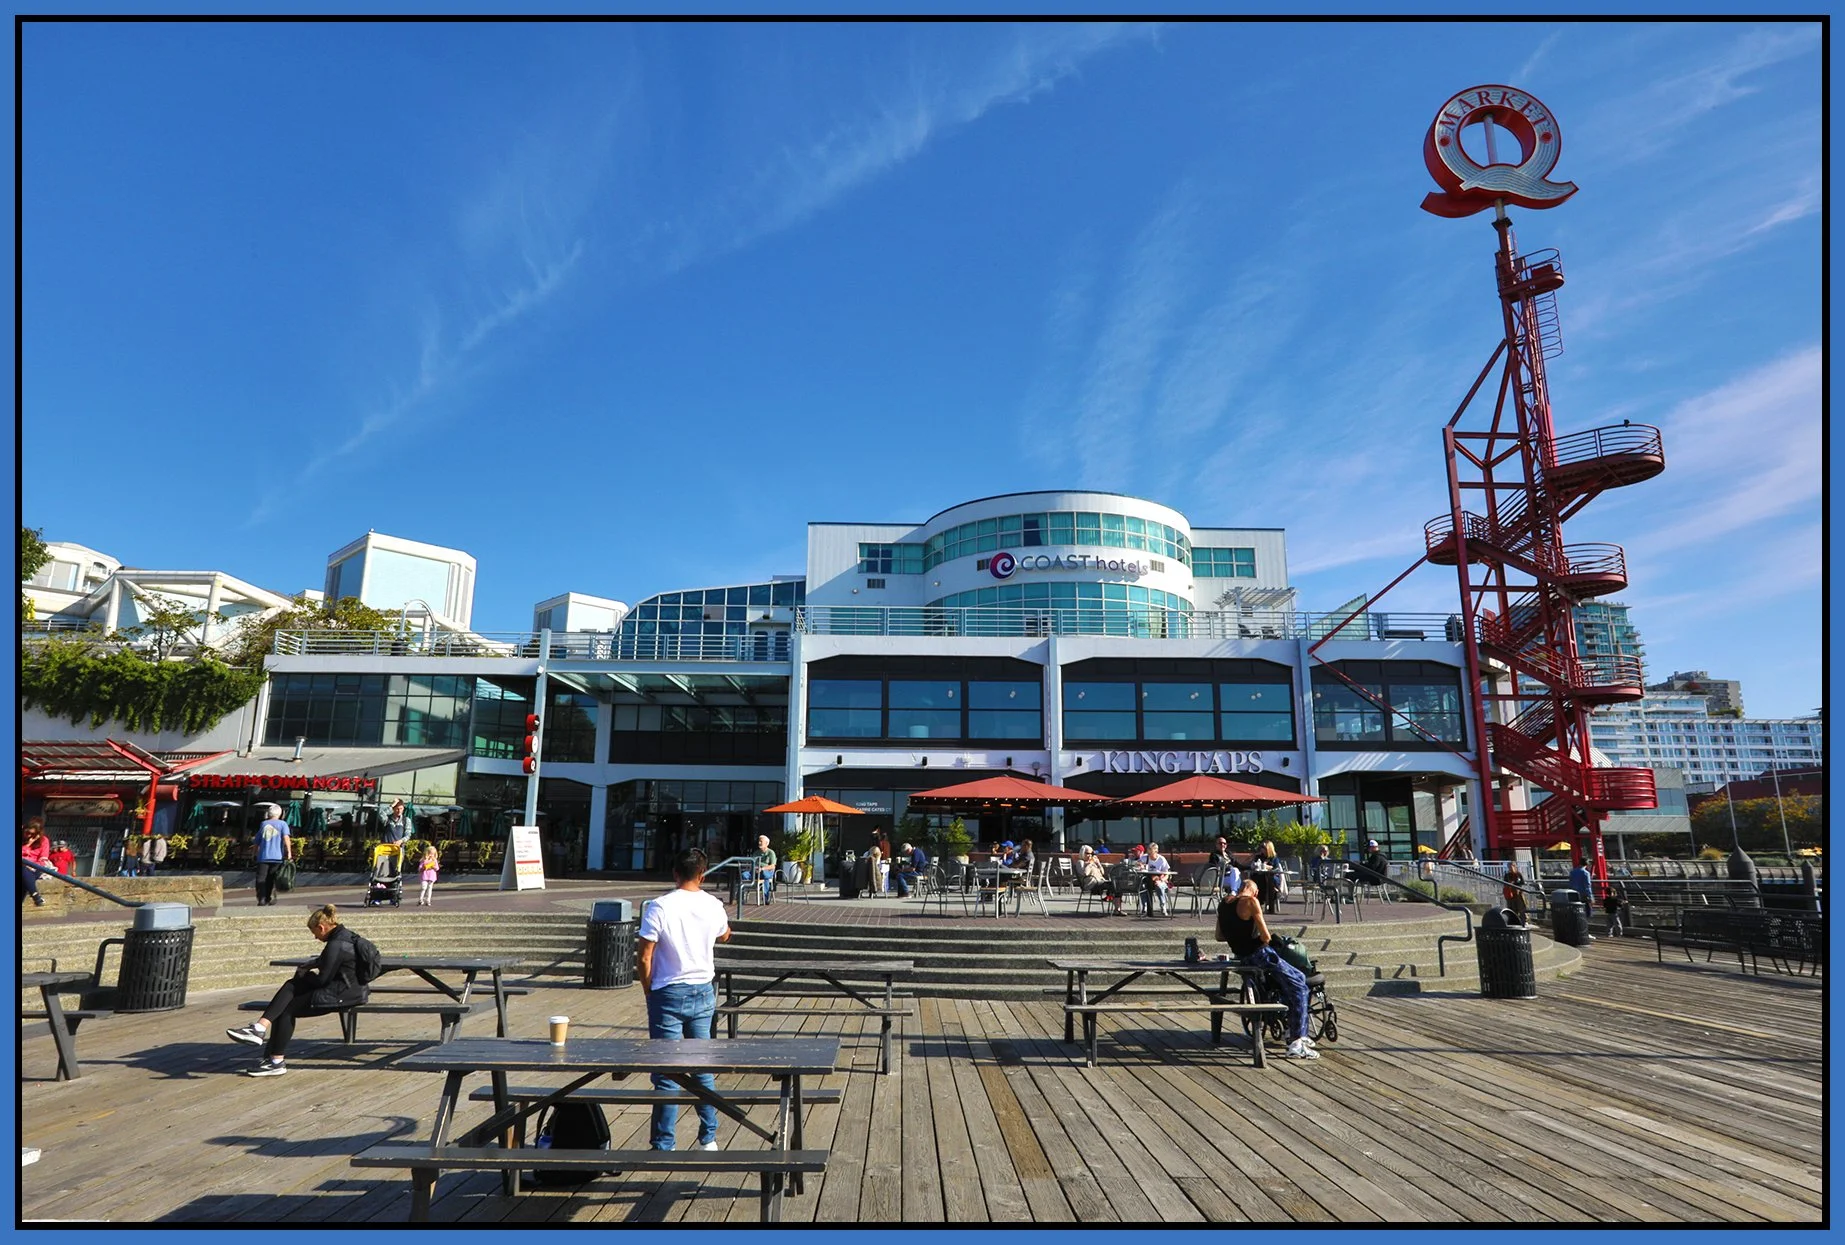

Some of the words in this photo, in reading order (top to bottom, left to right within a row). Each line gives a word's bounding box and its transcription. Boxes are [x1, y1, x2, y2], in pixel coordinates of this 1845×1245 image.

[1438, 90, 1551, 131] MARKET
[1021, 554, 1091, 571] COAST
[1096, 555, 1148, 576] hotels
[1102, 750, 1181, 774] KING
[1188, 750, 1264, 774] TAPS
[190, 774, 309, 790] STRATHCONA
[312, 775, 377, 792] NORTH
